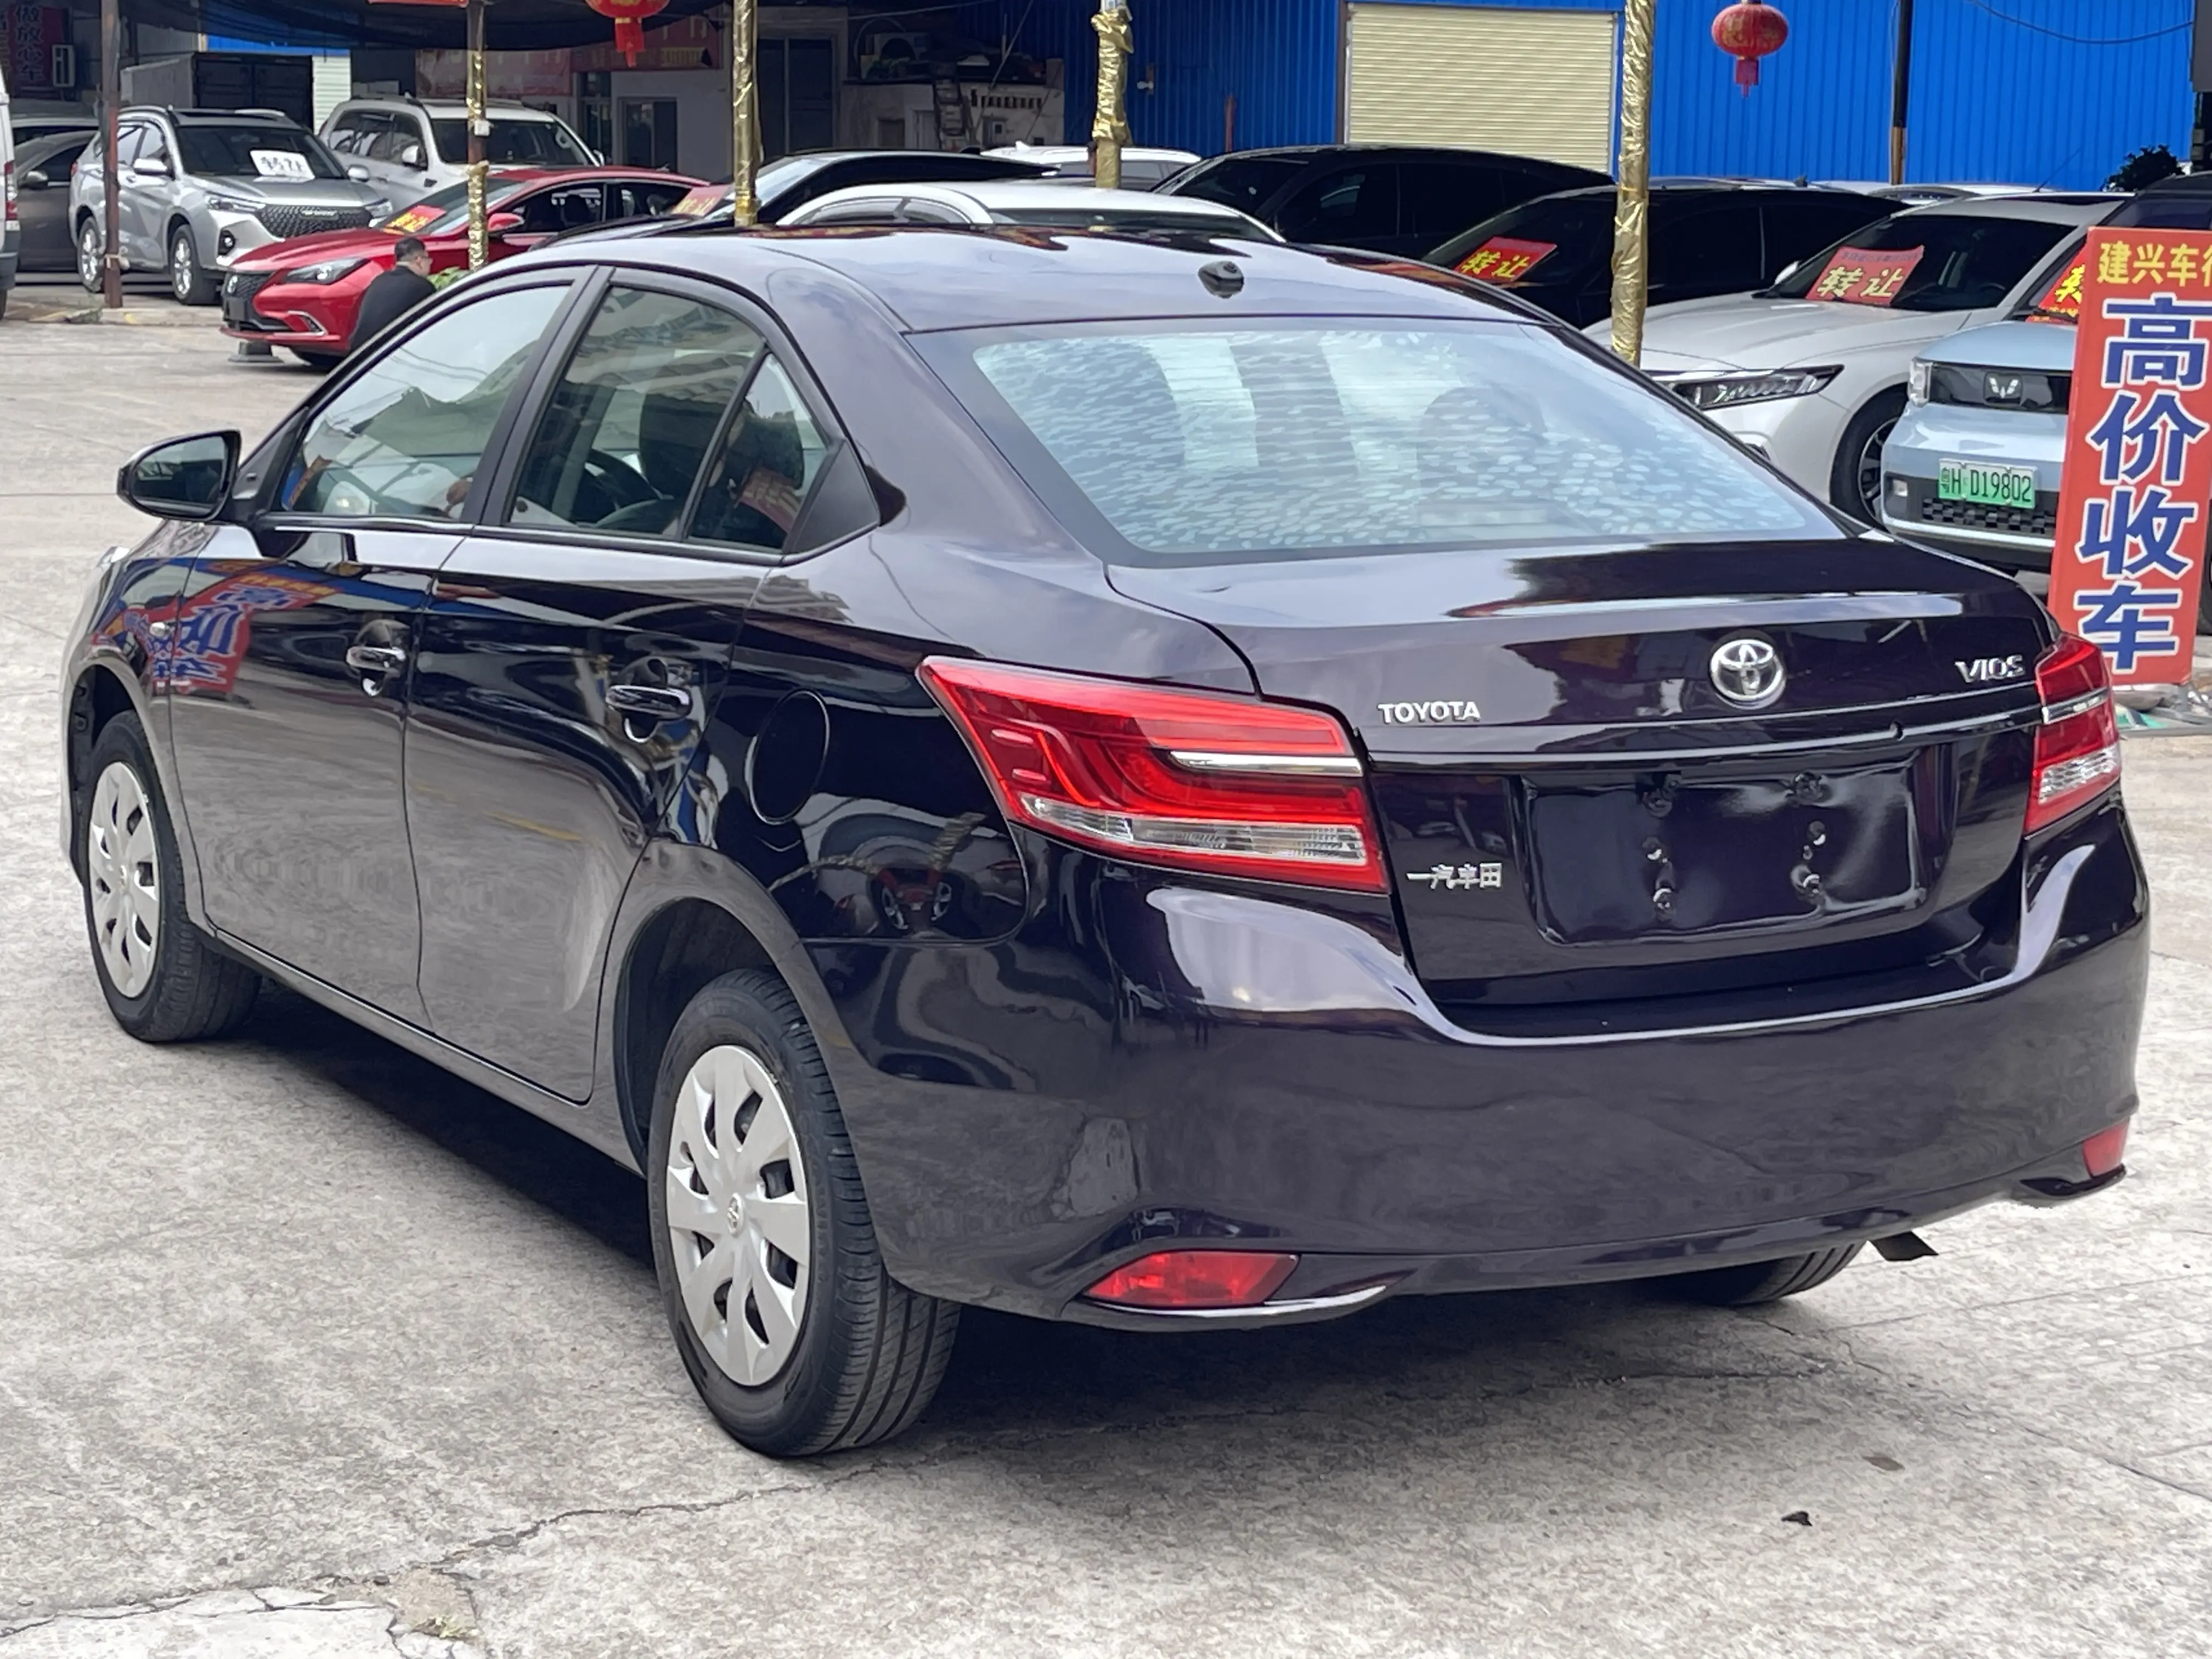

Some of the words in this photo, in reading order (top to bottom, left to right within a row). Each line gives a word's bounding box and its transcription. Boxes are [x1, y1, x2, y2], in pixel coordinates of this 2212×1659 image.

[1461, 250, 1531, 278] 转让
[1816, 266, 1904, 297] 转让
[2074, 292, 2212, 675] 高价收车
[1954, 654, 2025, 683] VIOS
[1376, 701, 1482, 725] TOYOTA
